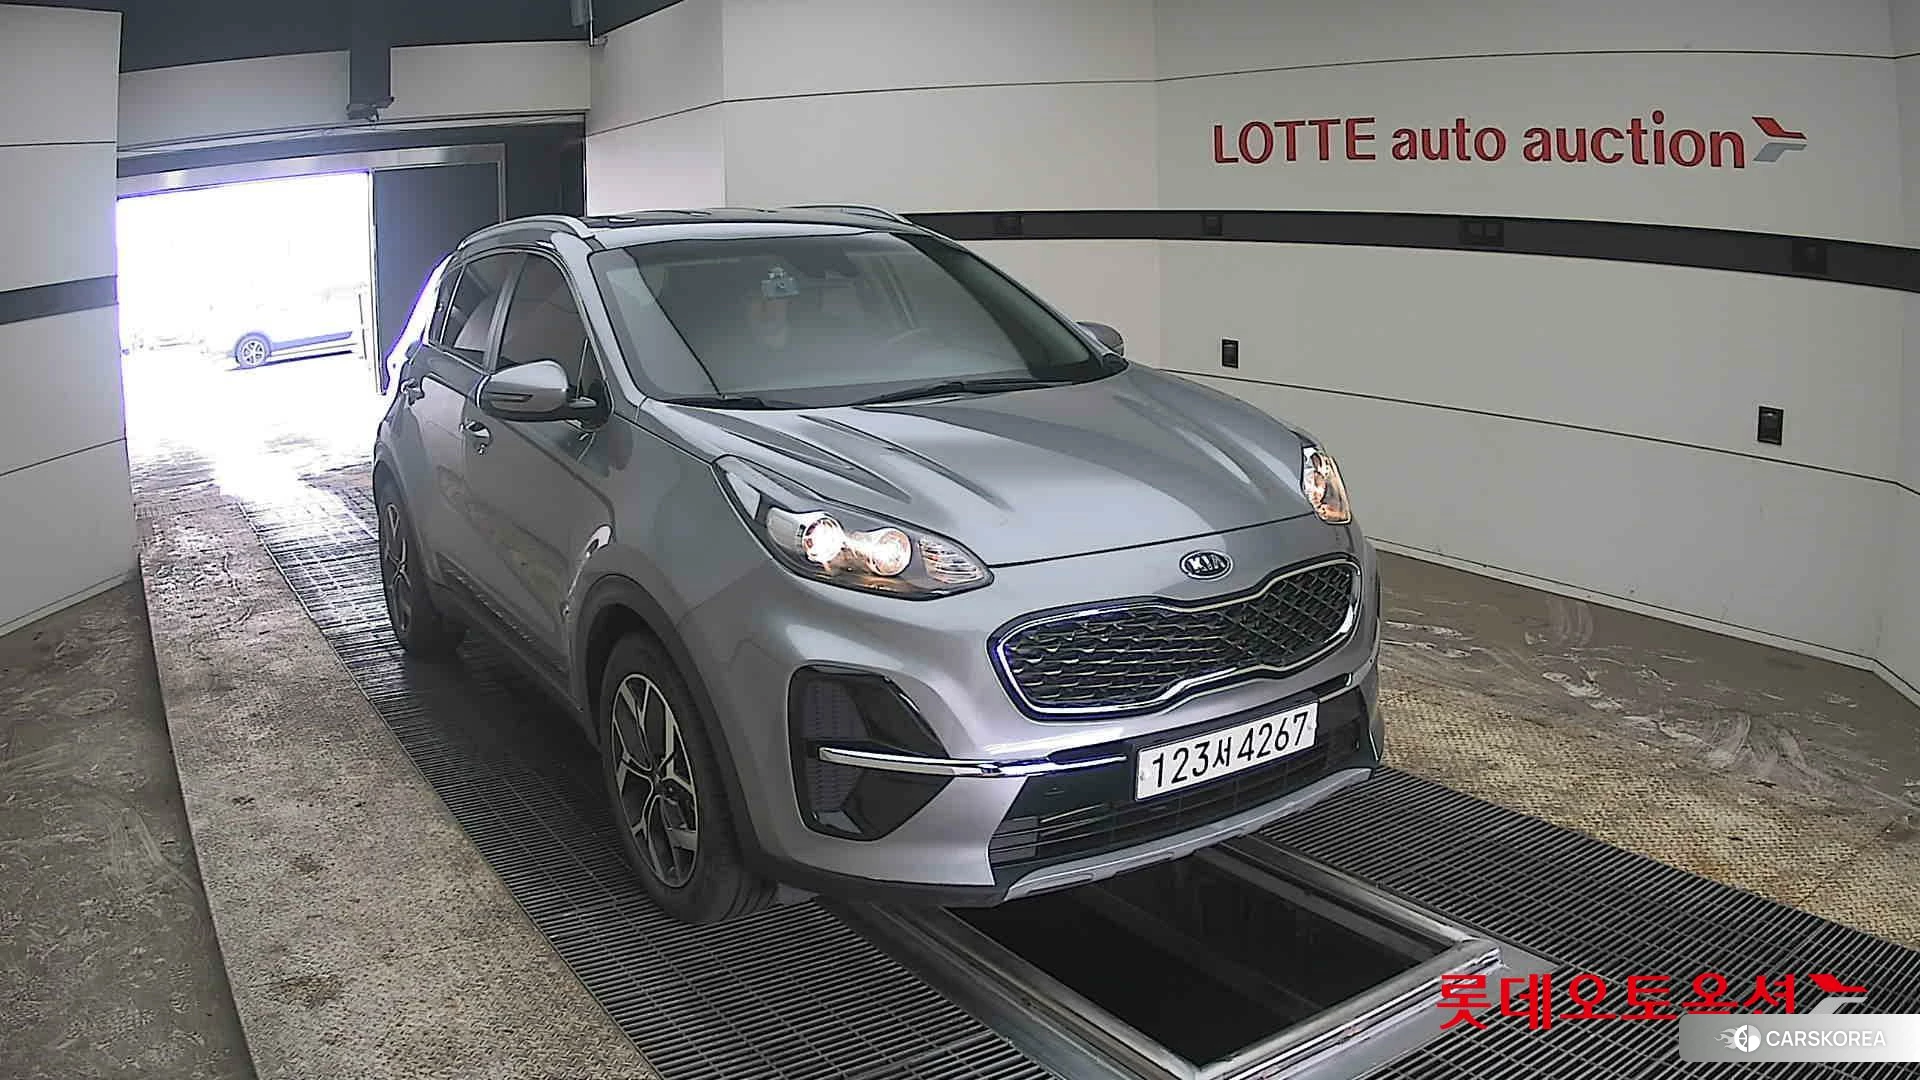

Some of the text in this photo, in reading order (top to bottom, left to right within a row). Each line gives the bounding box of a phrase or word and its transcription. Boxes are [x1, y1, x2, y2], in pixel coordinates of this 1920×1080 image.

[1213, 110, 1745, 169] LOTTE auto auction
[1187, 554, 1226, 573] KIA
